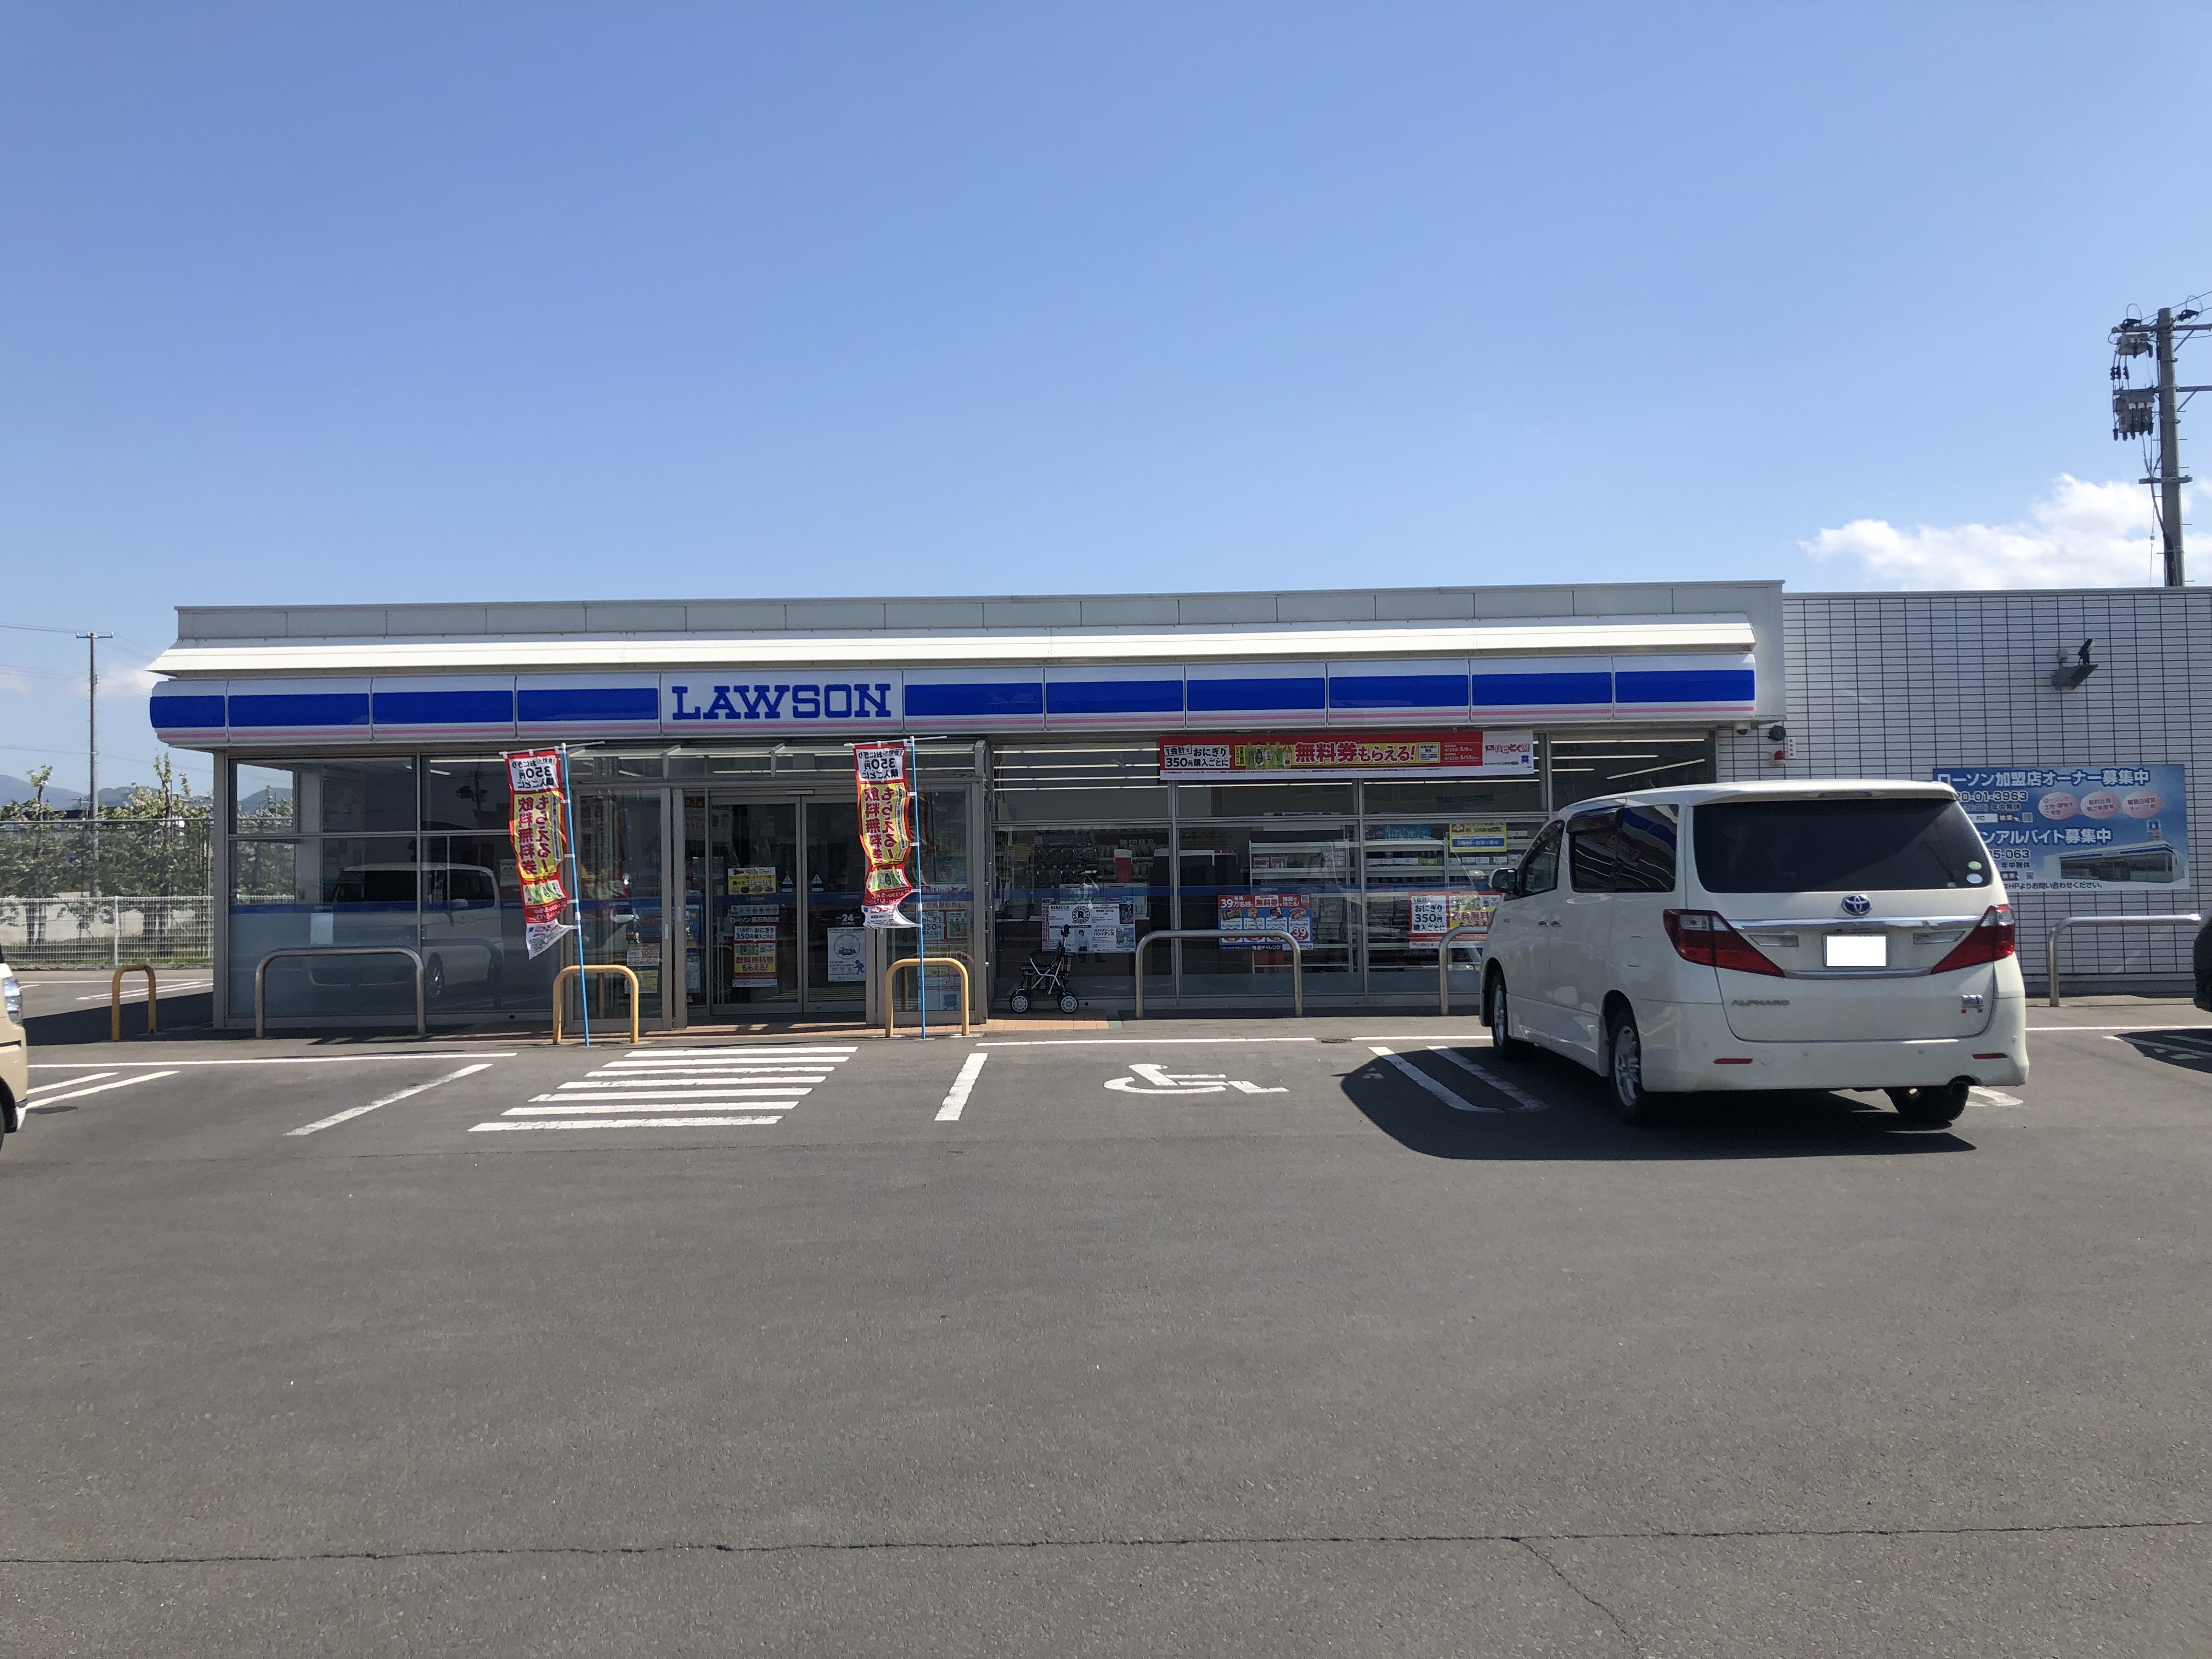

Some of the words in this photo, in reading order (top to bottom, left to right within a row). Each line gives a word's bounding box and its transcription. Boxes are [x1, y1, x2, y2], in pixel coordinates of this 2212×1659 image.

[672, 684, 891, 720] LAWSON
[1194, 747, 1226, 757] おにぎり
[1295, 742, 1415, 764] 無料券もらえる!
[1166, 758, 1228, 767] 350円購入ごとに
[1938, 769, 2149, 787] ローソン加盟店オーナー募集中
[1415, 904, 1442, 913] おにぎり
[842, 913, 854, 922] 24
[1414, 913, 1443, 923] 350円
[1293, 927, 1307, 936] 39
[1413, 923, 1446, 932] 購入ごとに
